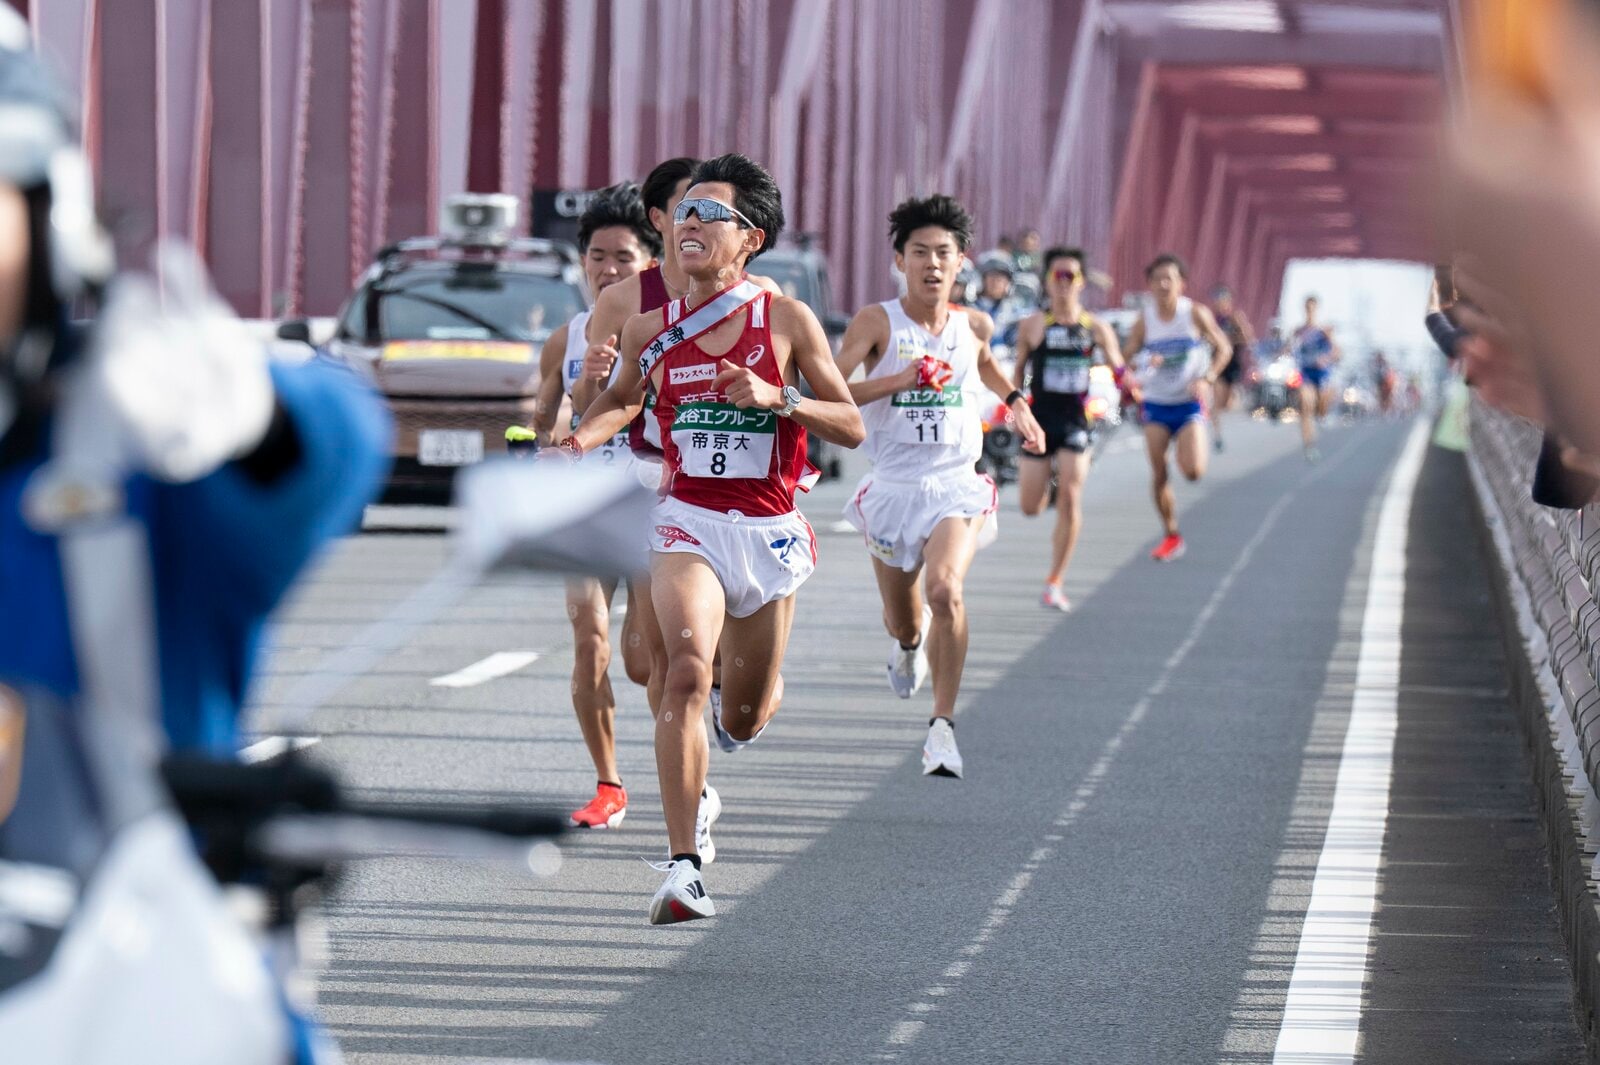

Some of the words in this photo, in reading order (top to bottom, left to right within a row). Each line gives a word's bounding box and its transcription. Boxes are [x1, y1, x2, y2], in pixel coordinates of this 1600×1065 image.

[906, 409, 949, 421] 中央大
[692, 432, 750, 451] 帝京大
[915, 423, 938, 442] 11
[710, 452, 727, 476] 8
